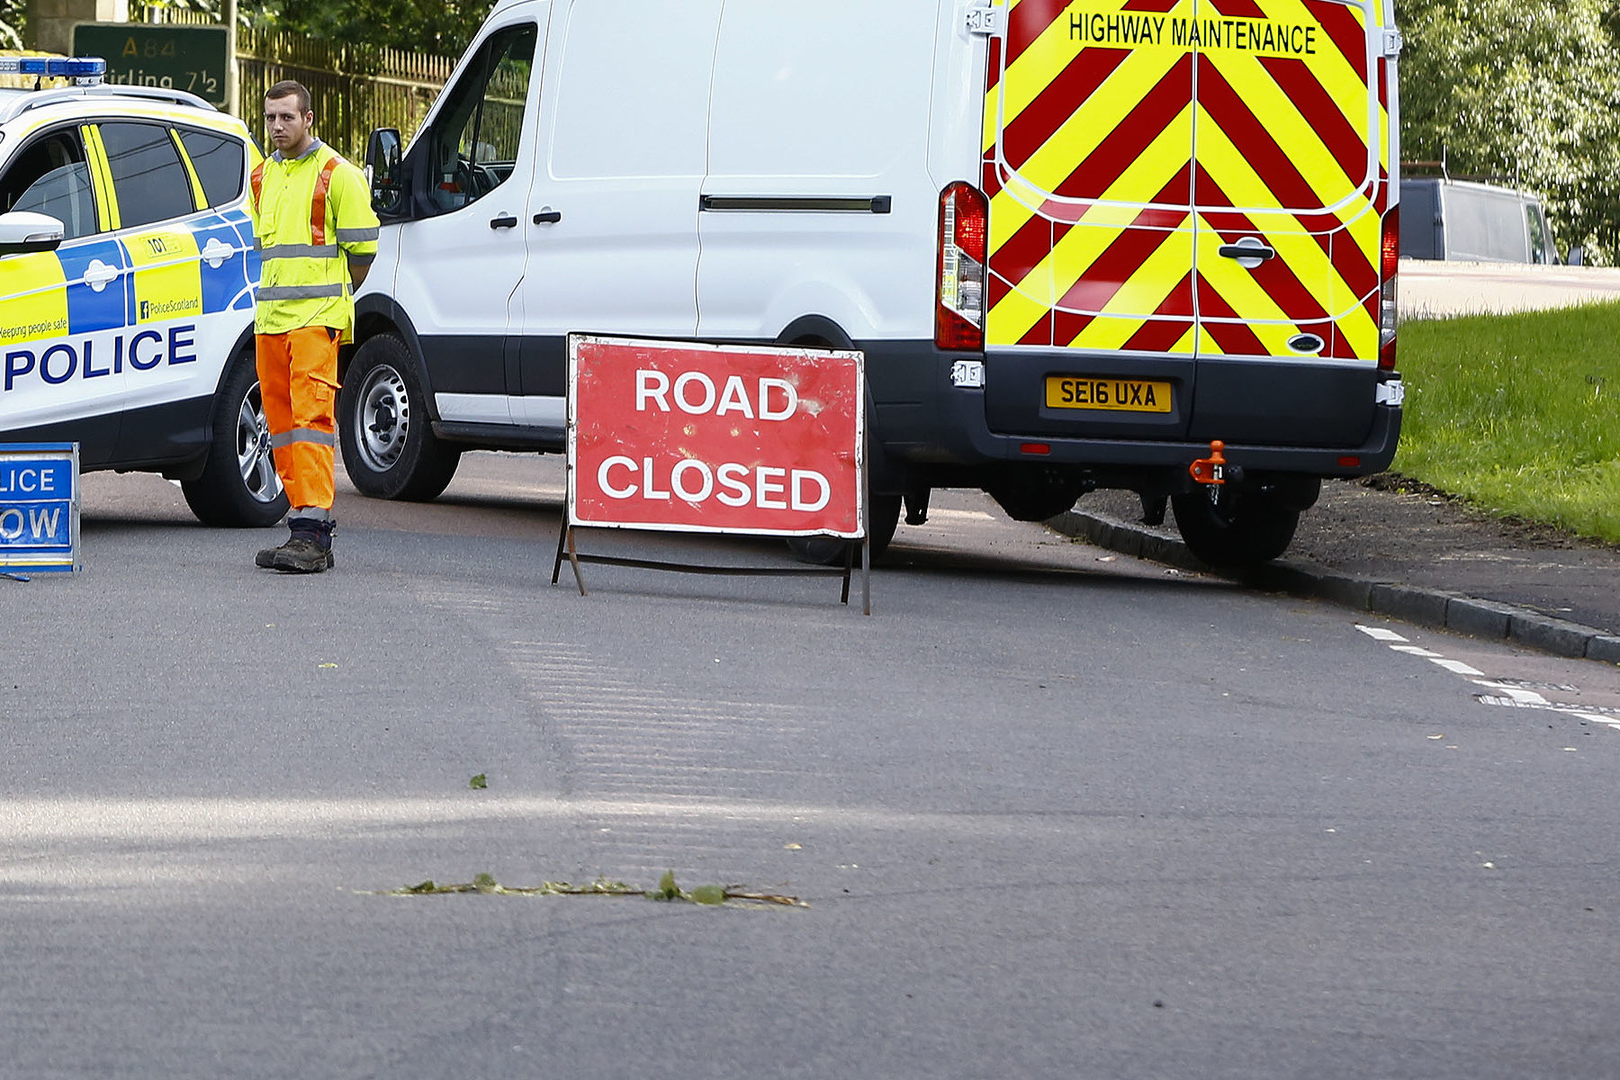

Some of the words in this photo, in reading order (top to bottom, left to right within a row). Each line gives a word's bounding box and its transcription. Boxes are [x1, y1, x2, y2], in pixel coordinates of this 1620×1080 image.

[1070, 12, 1165, 45] HIGHWAY
[1172, 18, 1316, 55] MAINTENANCE
[147, 237, 168, 254] 101
[28, 319, 52, 337] people
[53, 318, 68, 331] safe
[4, 324, 197, 391] POLICE
[635, 369, 798, 421] ROAD
[1061, 380, 1109, 404] SE16
[1115, 382, 1156, 406] UXA
[597, 455, 831, 512] CLOSED
